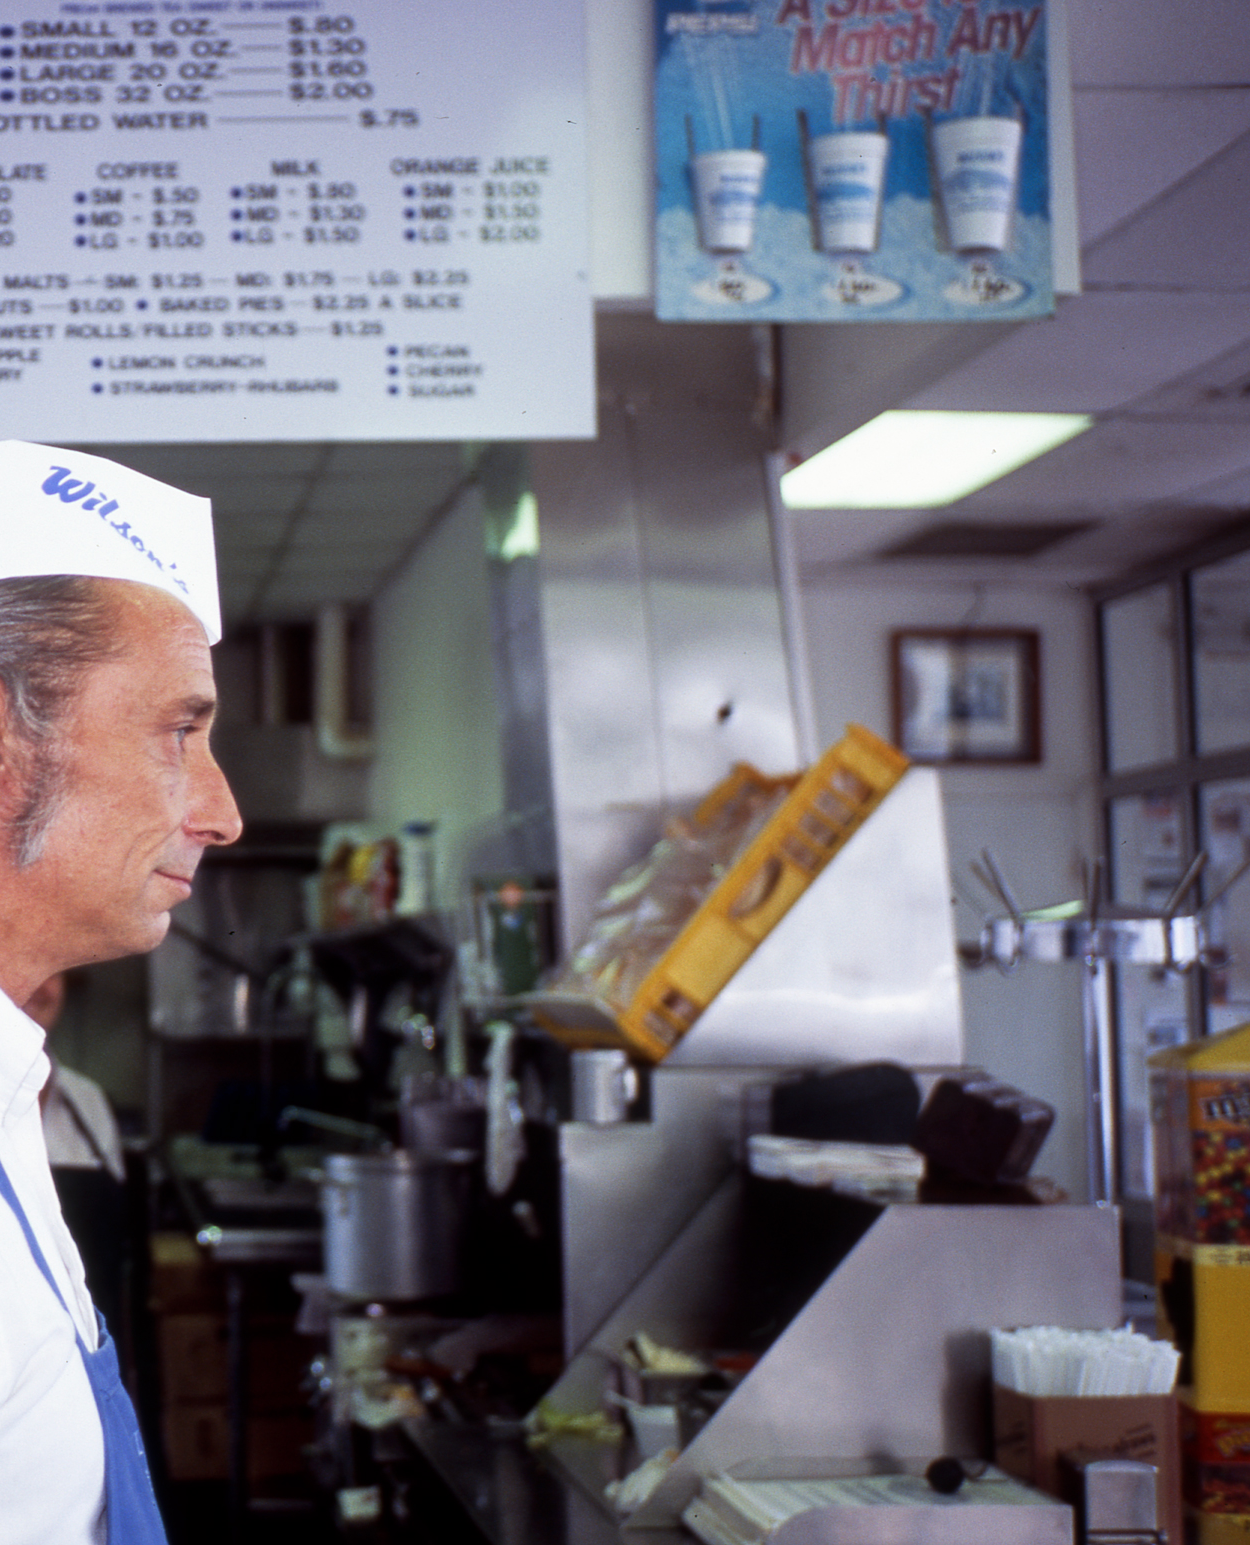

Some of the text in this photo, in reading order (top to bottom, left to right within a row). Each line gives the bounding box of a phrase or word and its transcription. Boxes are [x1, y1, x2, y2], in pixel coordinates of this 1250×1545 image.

[20, 21, 115, 39] SMALL
[130, 19, 159, 38] 12
[791, 13, 938, 74] Match
[947, 6, 1041, 60] Any
[19, 42, 136, 60] MEDIUM
[19, 64, 115, 83] LARGE
[130, 62, 168, 81] 20
[21, 86, 103, 103] BOSS
[116, 85, 152, 103] 32
[288, 80, 375, 101] $2.00
[834, 67, 958, 125] Thirst
[112, 112, 208, 130] WATER
[359, 109, 420, 129] $.75
[96, 161, 179, 180] COFFEE
[3, 274, 71, 290] MALTS
[41, 465, 190, 594] Wilson's
